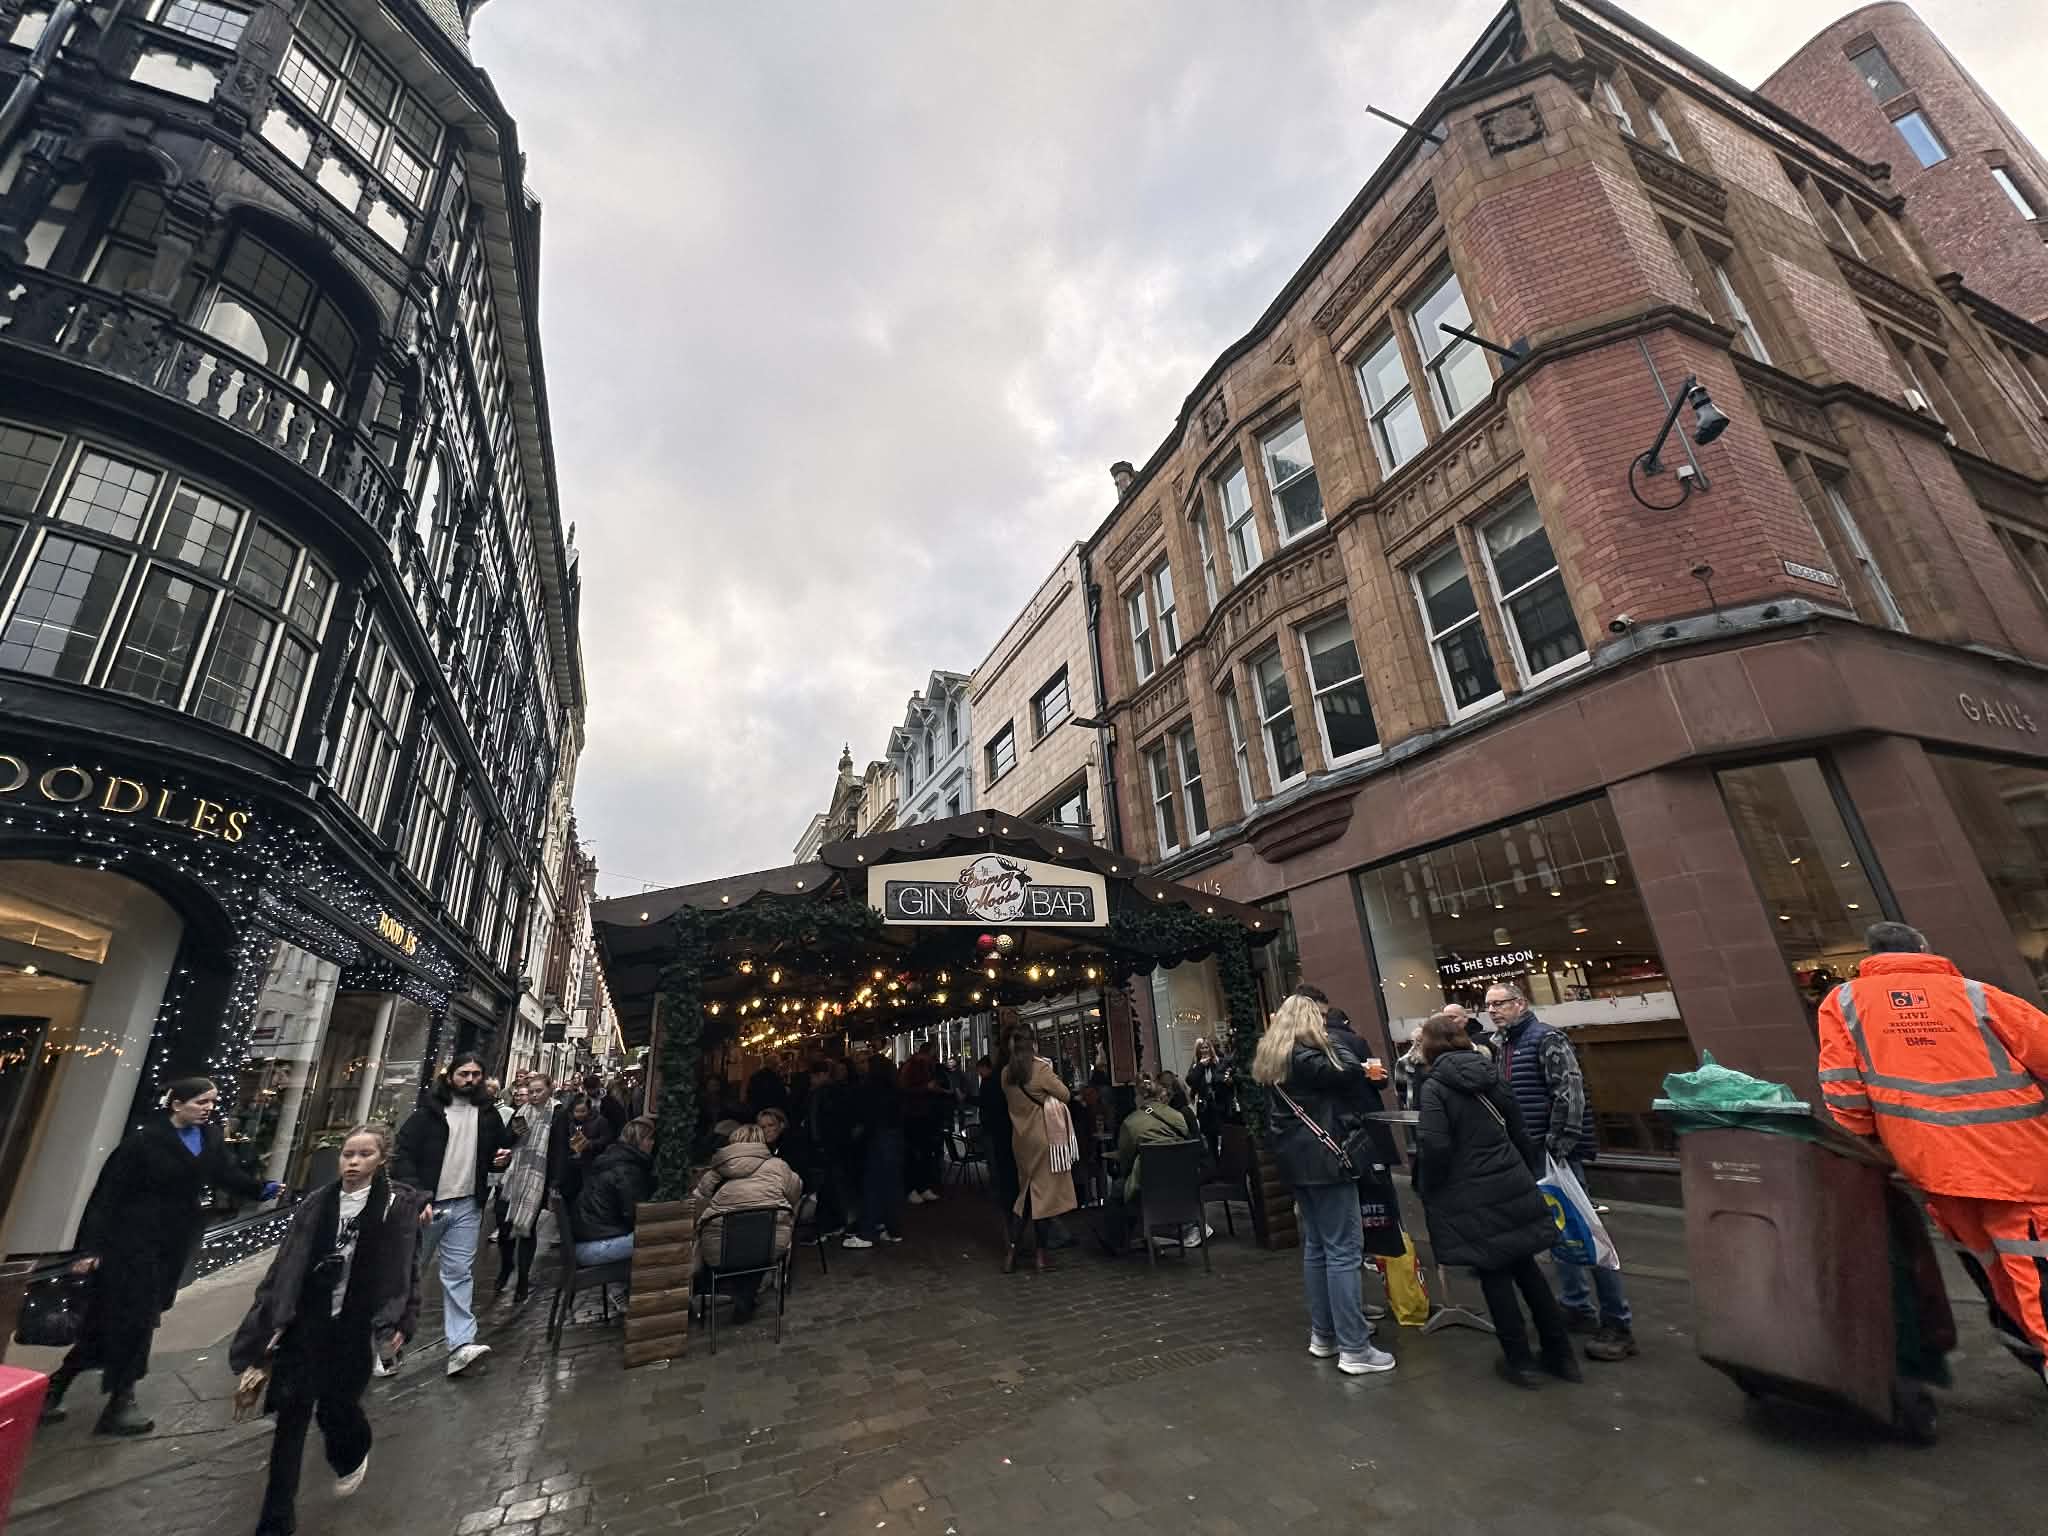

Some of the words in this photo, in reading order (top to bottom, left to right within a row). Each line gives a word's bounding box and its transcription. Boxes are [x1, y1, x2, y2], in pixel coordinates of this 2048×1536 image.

[899, 887, 951, 915] GIN
[1031, 890, 1088, 916] BAR
[1461, 959, 1484, 971] THE
[1485, 949, 1534, 967] SEASON
[1898, 1011, 1929, 1020] LIVE
